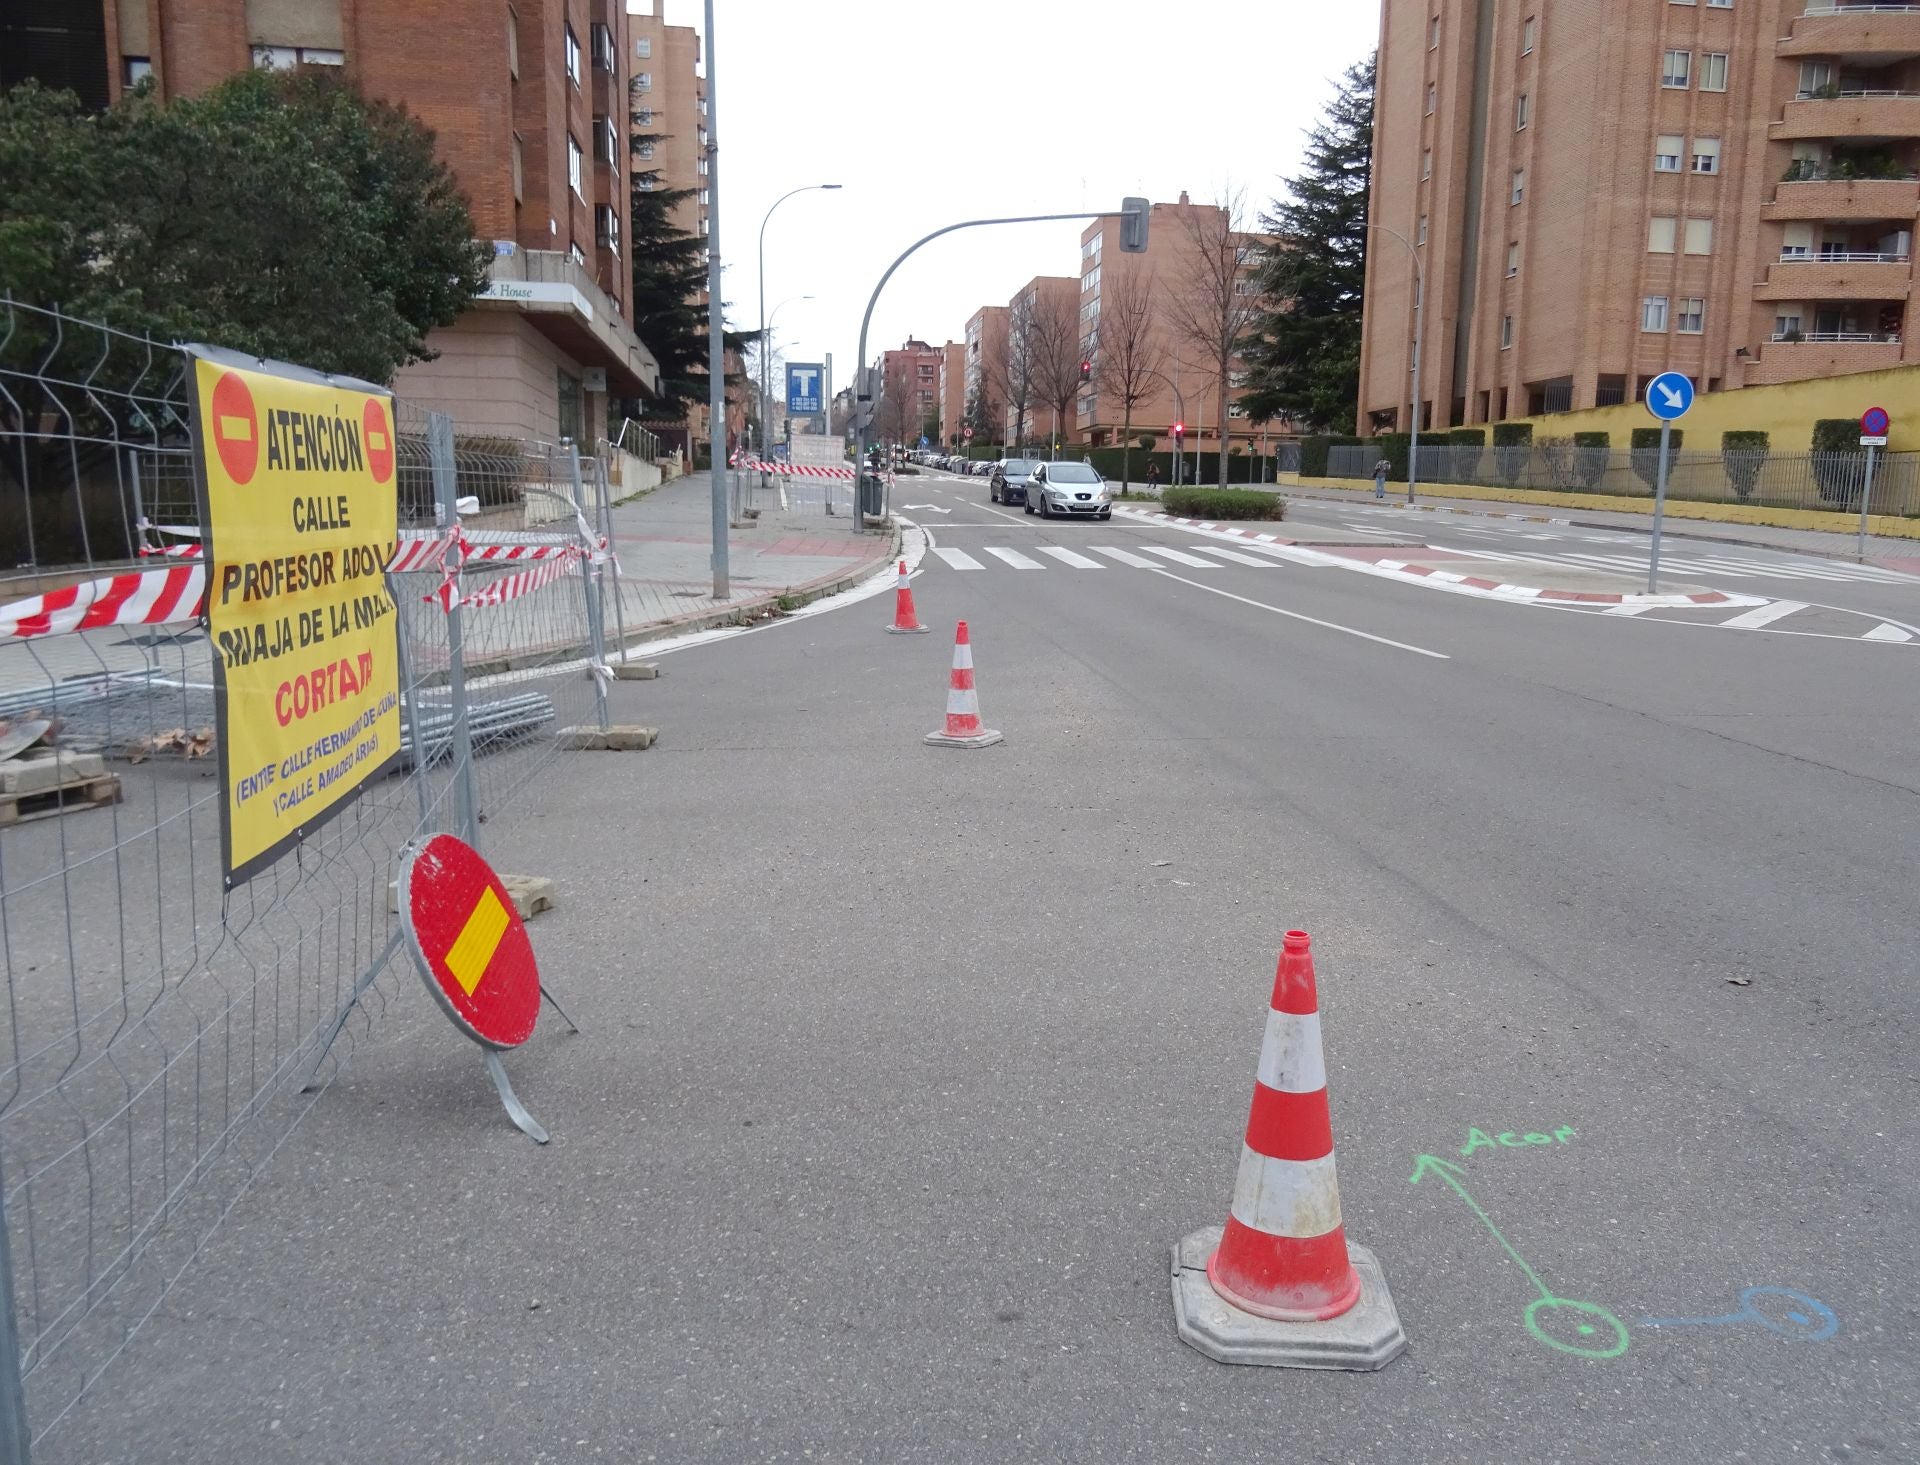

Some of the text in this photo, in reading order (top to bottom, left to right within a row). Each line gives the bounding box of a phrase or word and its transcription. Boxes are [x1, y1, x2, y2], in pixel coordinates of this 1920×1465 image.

[500, 284, 532, 298] House
[792, 370, 817, 396] T
[268, 404, 364, 472] ATENCIÓN
[293, 495, 351, 533] CALLE
[222, 551, 336, 605] PROFESOR
[299, 608, 324, 648] DE
[330, 601, 349, 638] LA
[281, 746, 313, 779] CALLE
[363, 707, 376, 728] DE
[279, 778, 314, 811] CALLE
